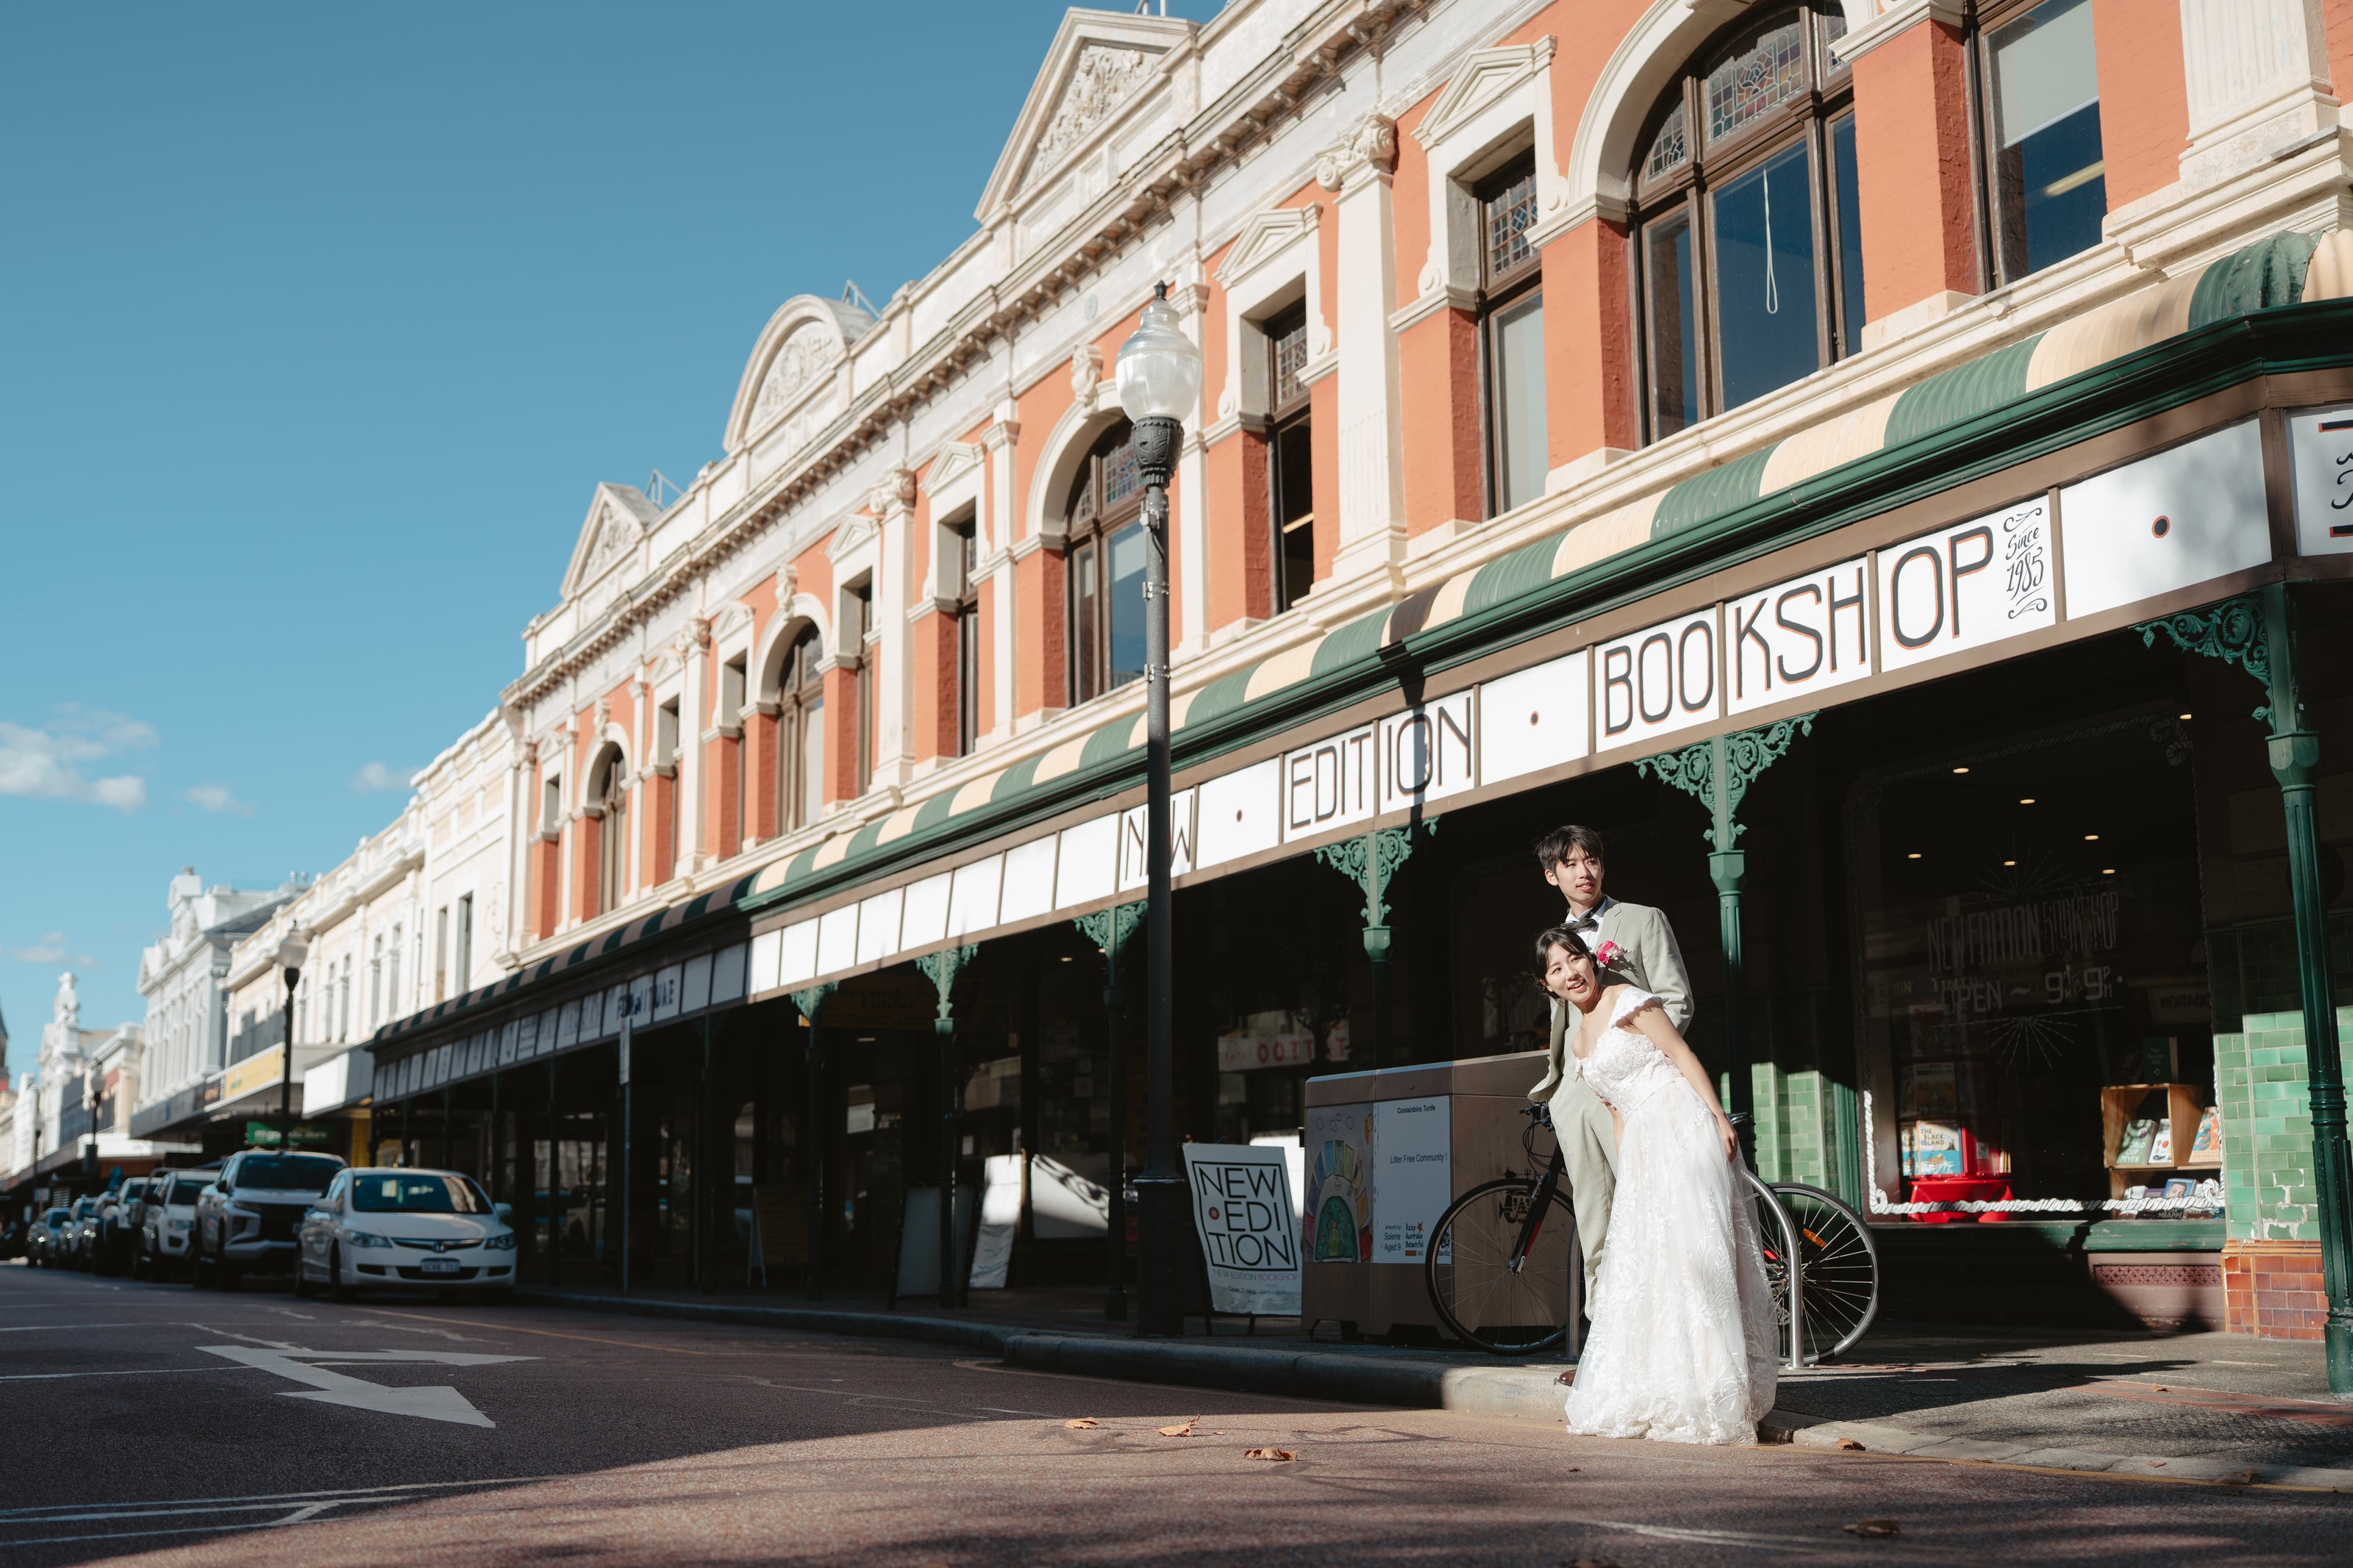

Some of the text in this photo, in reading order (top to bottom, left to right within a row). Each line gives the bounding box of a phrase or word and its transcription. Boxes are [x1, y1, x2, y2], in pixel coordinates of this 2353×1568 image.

[2006, 527, 2040, 560] Since
[2006, 546, 2044, 601] 1985
[1125, 526, 1994, 881] NW EDITION BOOKSHOP
[1940, 979, 2003, 1015] OPEN
[1390, 1156, 1402, 1164] Litter
[1404, 1155, 1415, 1163] Free
[1416, 1153, 1444, 1163] Community
[1199, 1167, 1277, 1198] NEW
[1224, 1200, 1281, 1232] EDI
[1405, 1223, 1416, 1232] Keep
[1208, 1232, 1290, 1266] TION
[1385, 1243, 1396, 1253] Aged
[1405, 1240, 1424, 1248] Beautiful
